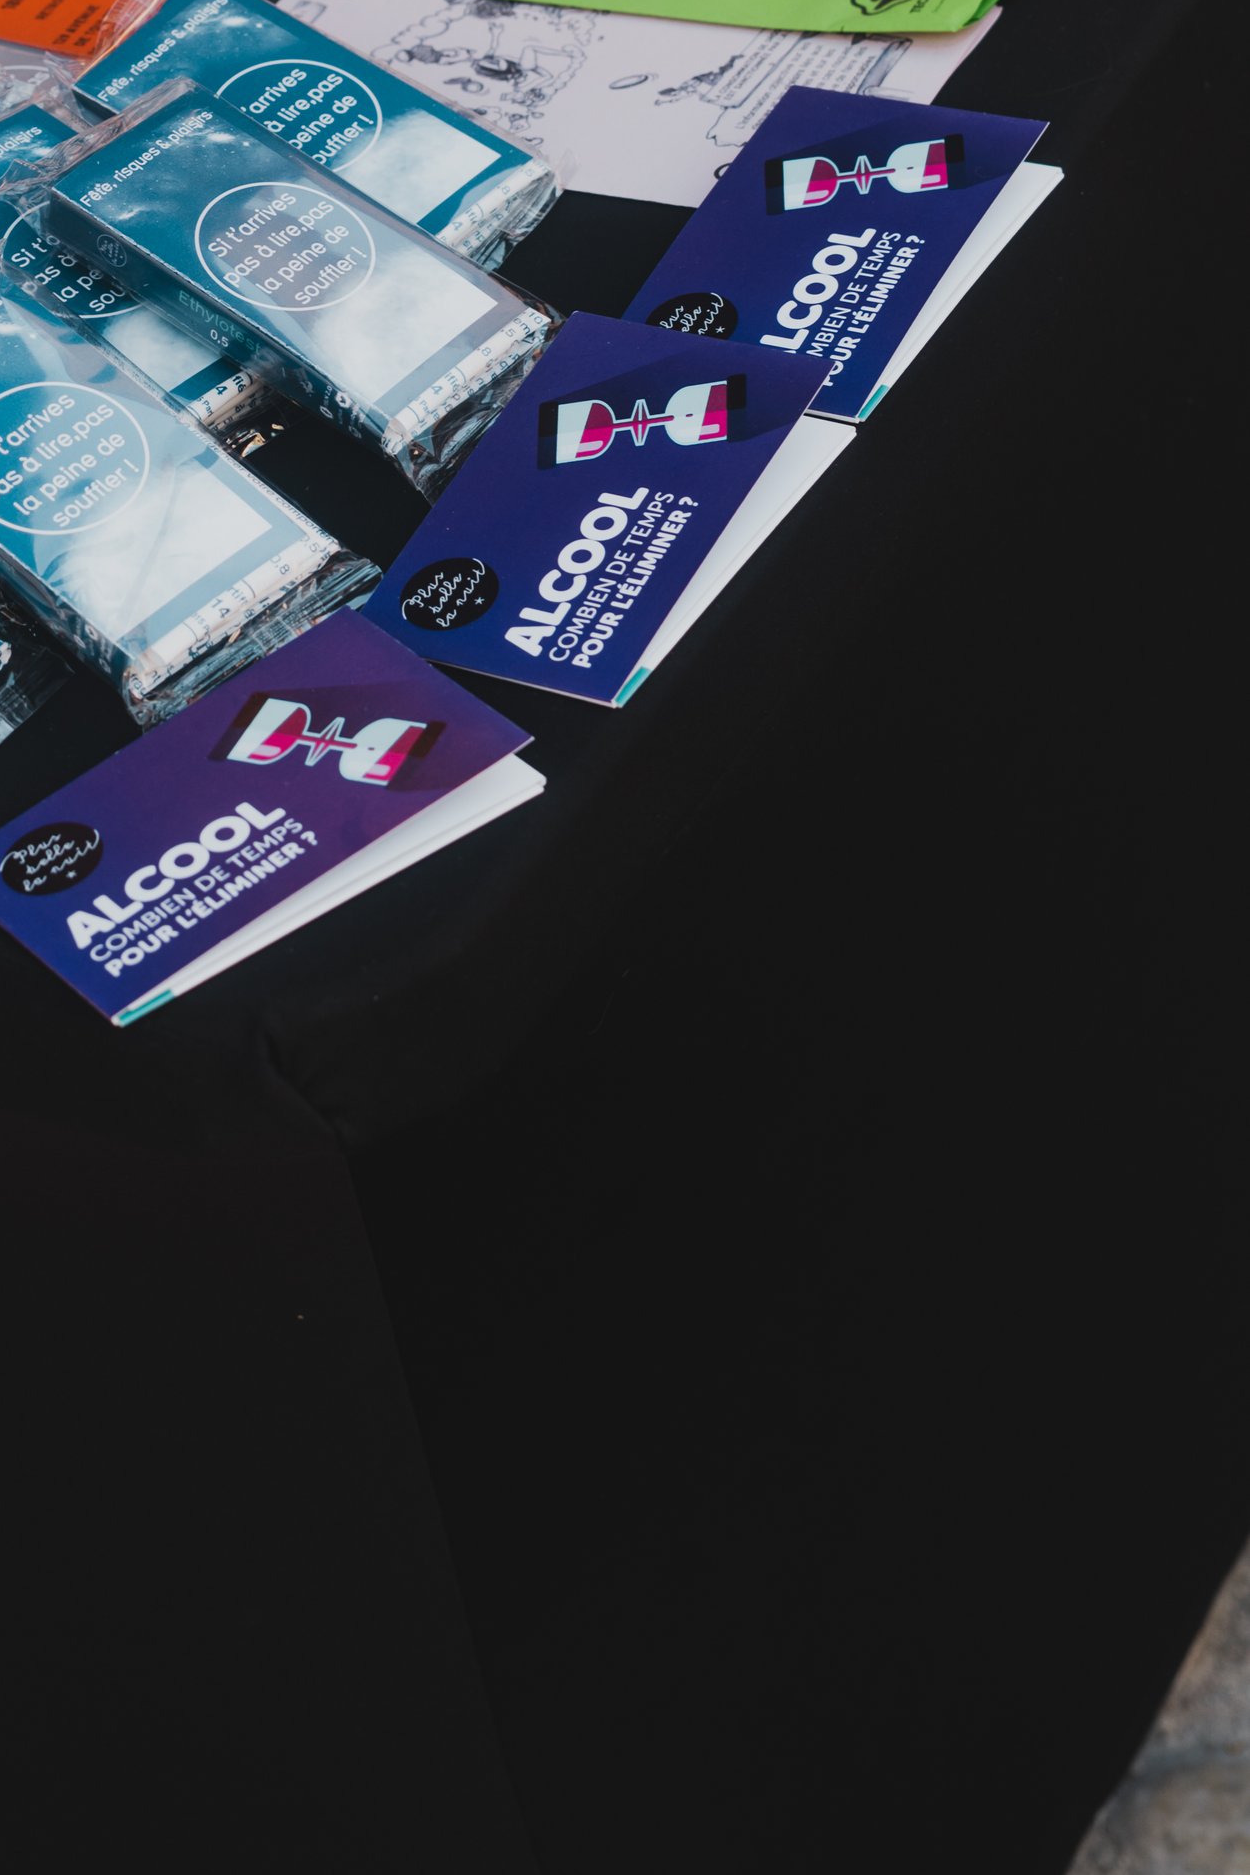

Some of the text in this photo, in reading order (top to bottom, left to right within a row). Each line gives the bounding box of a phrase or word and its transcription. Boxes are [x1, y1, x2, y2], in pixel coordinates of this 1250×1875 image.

[97, 74, 134, 102] Fête,
[130, 37, 176, 77] risques
[172, 29, 186, 40] &
[240, 68, 307, 116] 'arrives
[264, 120, 286, 133] à
[332, 95, 357, 115] de
[80, 110, 213, 208] Fête, risques & plaisirs
[312, 122, 365, 165] ouffler
[12, 248, 33, 267] Si
[207, 192, 297, 258] Si t'arrives
[21, 265, 60, 295] pas
[222, 256, 261, 288] pas
[256, 243, 277, 258] à
[255, 224, 350, 295] la peine de
[294, 254, 359, 305] souffler
[759, 228, 877, 351] LCOOL
[847, 246, 920, 334] L'ÉLIMINER
[906, 235, 925, 245] ?
[53, 286, 78, 302] la
[178, 289, 263, 353] Ethylotest
[806, 231, 902, 357] MBIEN DE TEMPS
[13, 432, 125, 515] la peine de
[19, 456, 42, 472] à
[52, 470, 129, 528] souffler
[436, 558, 485, 627] la nuit
[504, 487, 649, 657] ALCOOL
[549, 491, 674, 662] COMBIEN DE TEMPS
[572, 496, 699, 668] POUR L'ÉLIMINER ?
[23, 876, 47, 891] la
[66, 802, 286, 949] ALCOOL
[90, 818, 303, 961] COMBIEN DE TEMPS
[104, 831, 318, 977] POUR L'ÉLIMINER ?
